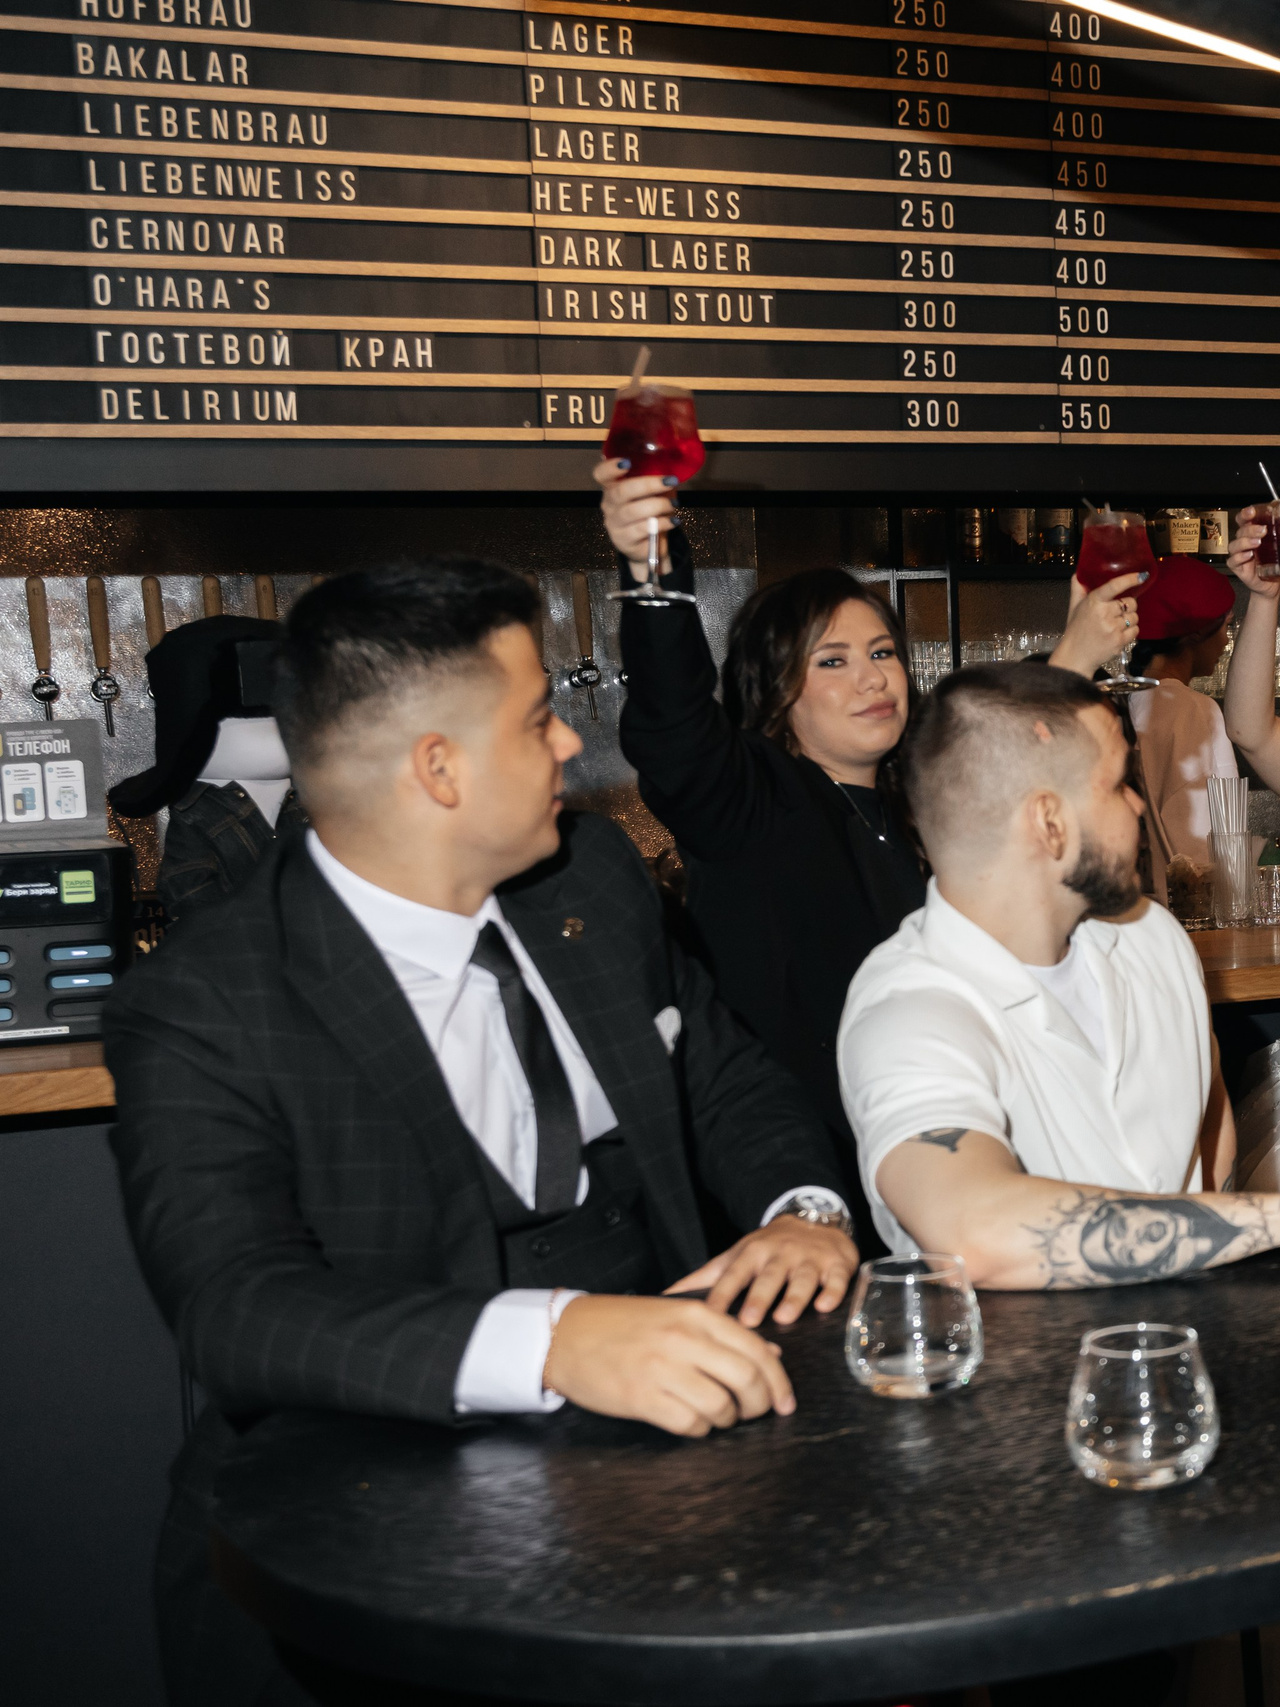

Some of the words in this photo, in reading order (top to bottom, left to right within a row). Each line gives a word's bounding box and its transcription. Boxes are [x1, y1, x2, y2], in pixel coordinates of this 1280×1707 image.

[81, 0, 251, 28] HOFBRAU
[894, 0, 945, 27] 250
[1050, 12, 1100, 41] 400
[529, 20, 633, 55] LAGER
[77, 43, 248, 85] BAKALAR
[897, 48, 948, 78] 250
[1051, 62, 1100, 90] 400
[530, 74, 679, 111] PILSNER
[84, 102, 327, 145] LIEBENBRAU
[898, 99, 949, 128] 250
[1053, 112, 1102, 139] 400
[535, 128, 639, 162] LAGER
[899, 149, 951, 178] 250
[1058, 161, 1106, 188] 450
[90, 160, 355, 201] LIEBENWEISS
[535, 181, 739, 219] HEFE-WEISS
[901, 200, 953, 229] 250
[91, 217, 284, 254] CERNOVAR
[1056, 209, 1104, 236] 450
[540, 236, 622, 266] DARK
[651, 239, 750, 271] LAGER
[901, 250, 953, 278] 250
[1057, 258, 1106, 285] 400
[547, 289, 646, 320] IRISH
[675, 293, 773, 322] STOUT
[905, 301, 955, 328] 300
[1060, 306, 1108, 333] 500
[97, 330, 290, 365] ГОСТЕВОЙ
[345, 338, 432, 367] КРАН
[904, 350, 955, 377] 250
[1061, 355, 1109, 381] 400
[101, 389, 297, 421] DELIRIUM
[907, 400, 959, 427] 300
[1062, 403, 1110, 429] 550
[7, 739, 71, 757] ТЕЛЕФОН
[5, 888, 28, 897] Бери
